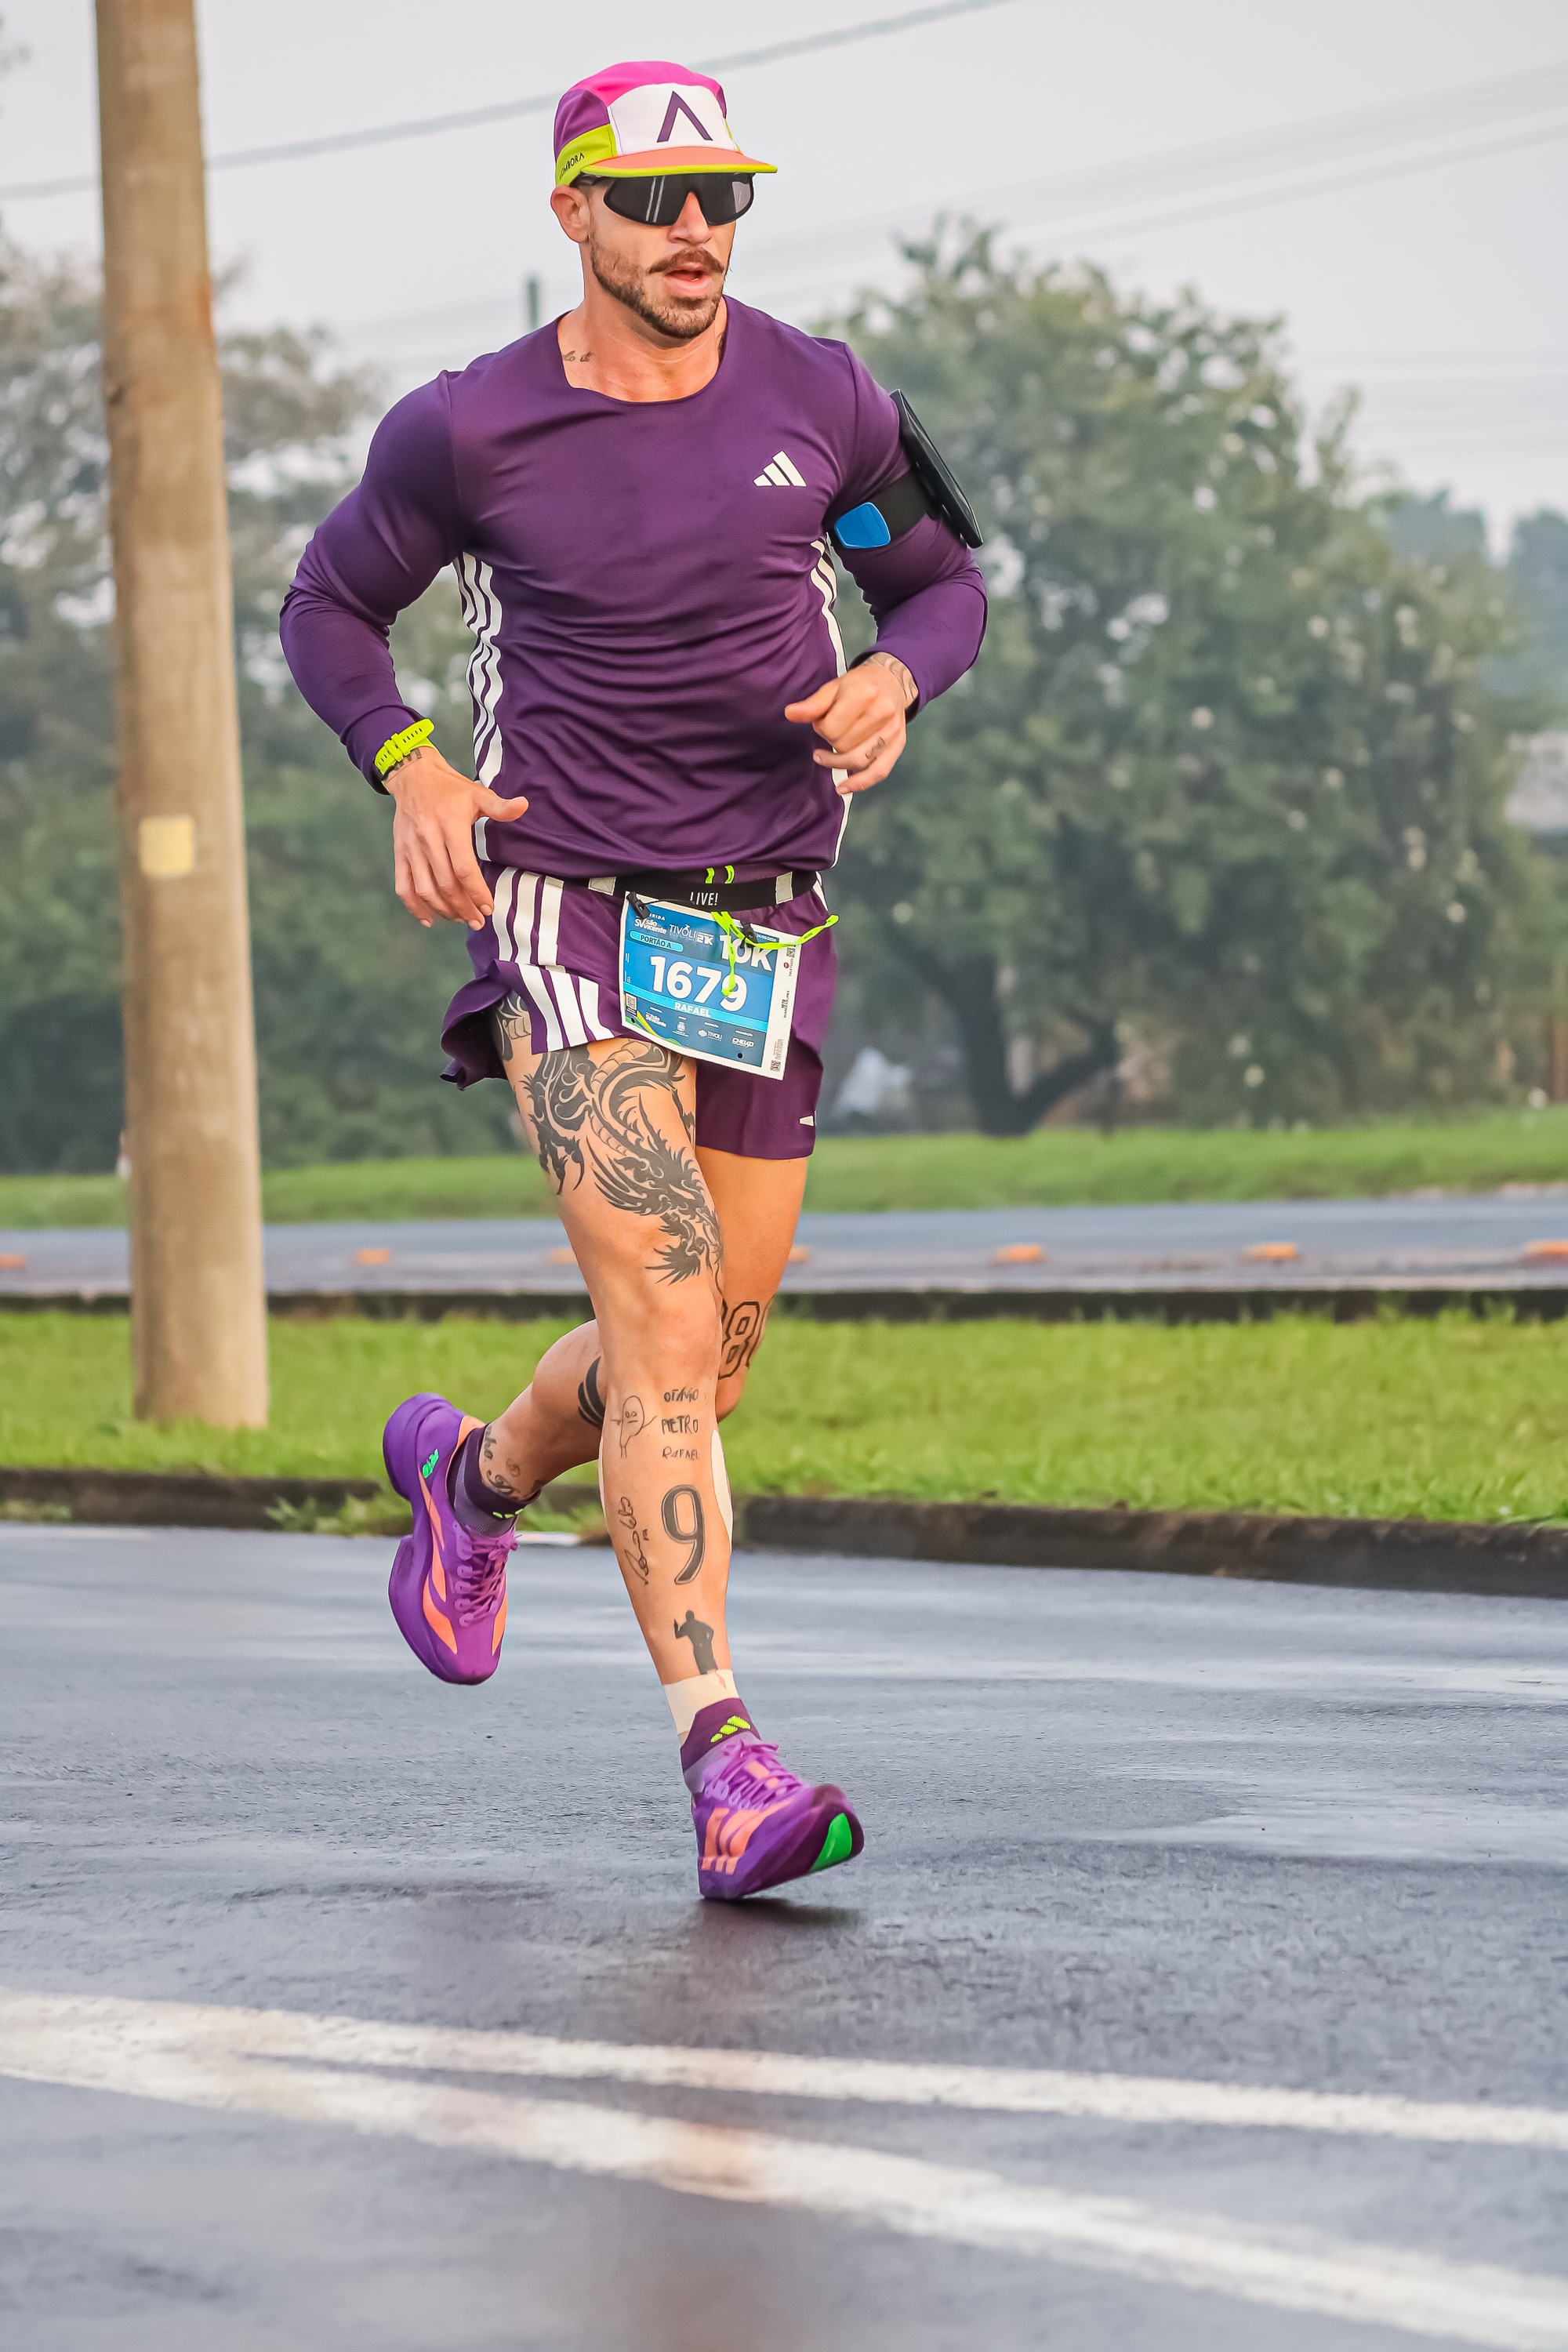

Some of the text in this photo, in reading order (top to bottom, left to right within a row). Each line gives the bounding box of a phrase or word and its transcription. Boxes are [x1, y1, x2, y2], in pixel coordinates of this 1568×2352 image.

[719, 935, 773, 972] 10K
[650, 956, 747, 1011] 1679
[674, 1001, 712, 1018] RAFAEL
[661, 1484, 706, 1584] 9
